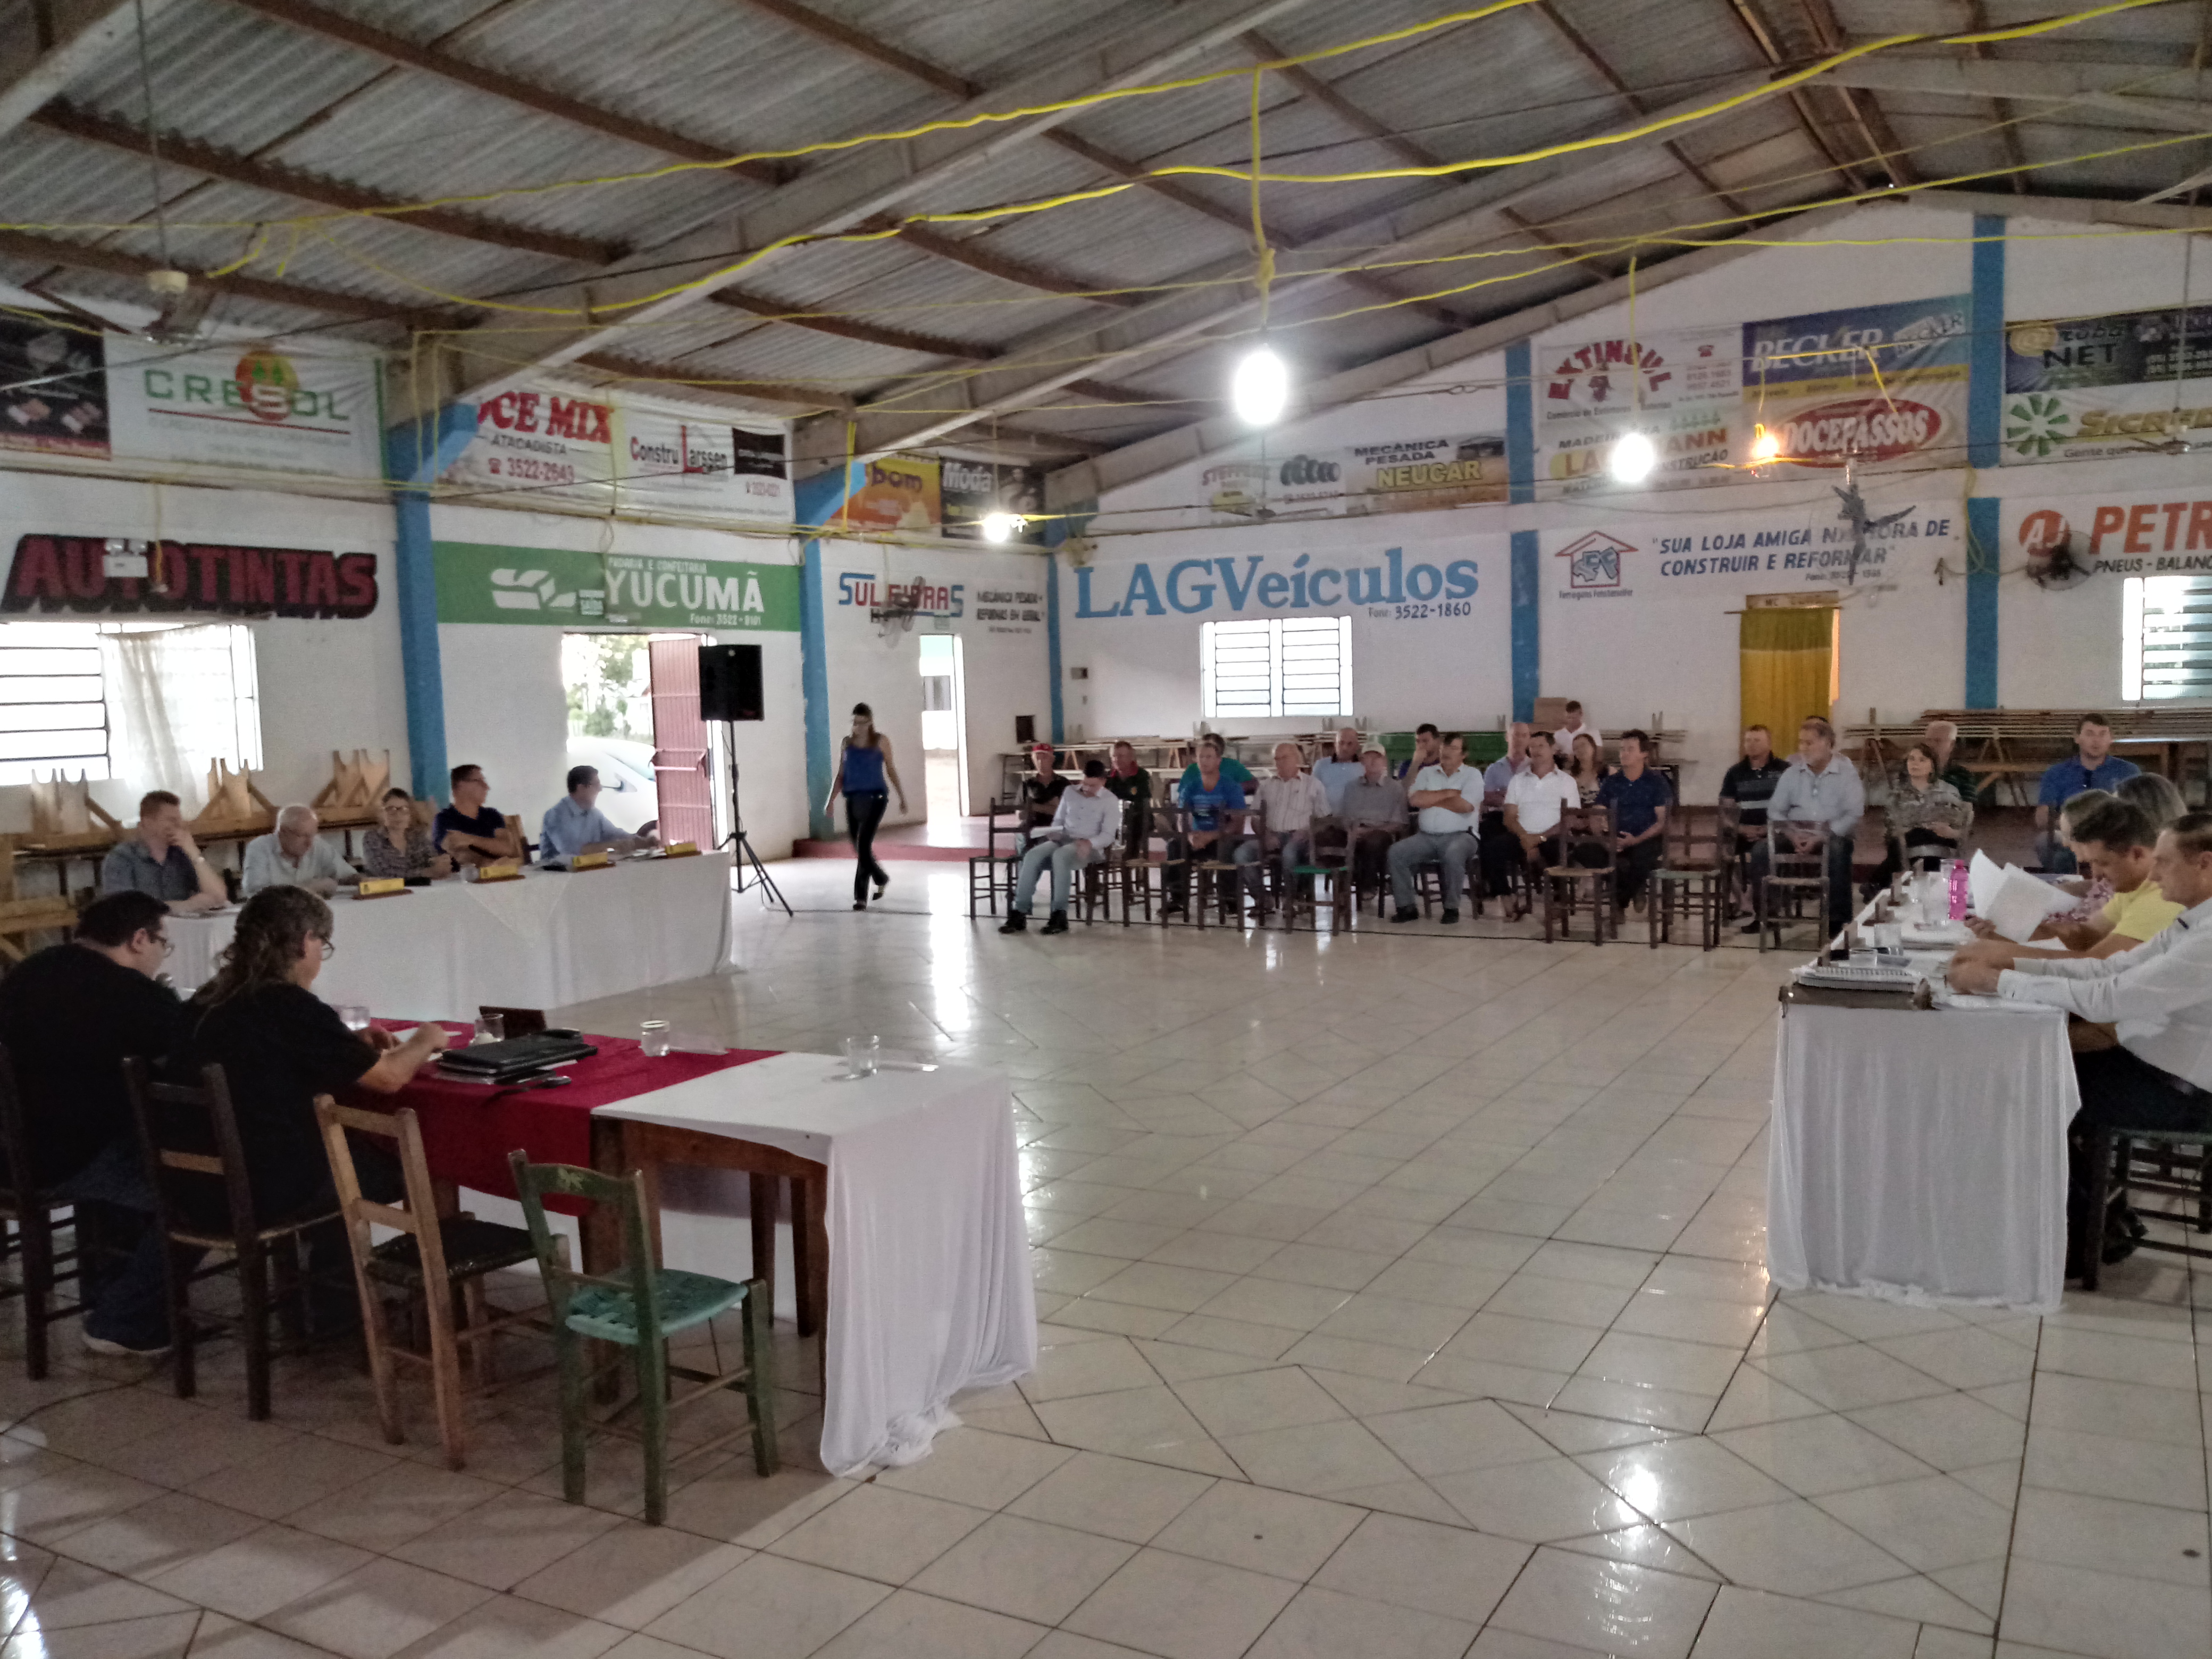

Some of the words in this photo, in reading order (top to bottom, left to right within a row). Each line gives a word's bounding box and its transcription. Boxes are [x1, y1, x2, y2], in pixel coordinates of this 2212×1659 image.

[1547, 339, 1671, 399] EXTINSUL
[2043, 343, 2116, 369] NET
[144, 369, 349, 421] CRESOL
[477, 391, 540, 432] CE
[545, 396, 614, 443] MIX
[490, 434, 567, 455] ATACADISTA
[630, 435, 679, 465] Constru
[681, 425, 728, 474] Larssen
[1354, 439, 1449, 457] MECÂNICA
[1365, 451, 1435, 465] PESADA
[1701, 533, 1746, 551] LOJA
[1753, 529, 1812, 548] AMIGA
[1925, 520, 1950, 537] DE
[2089, 500, 2212, 555] PETR
[1660, 555, 1759, 576] CONSTRUIR
[1767, 553, 1777, 569] E
[2094, 558, 2143, 573] PNEUS
[604, 569, 765, 613] YUCUMÃ
[1395, 601, 1471, 620] 3522-1860
